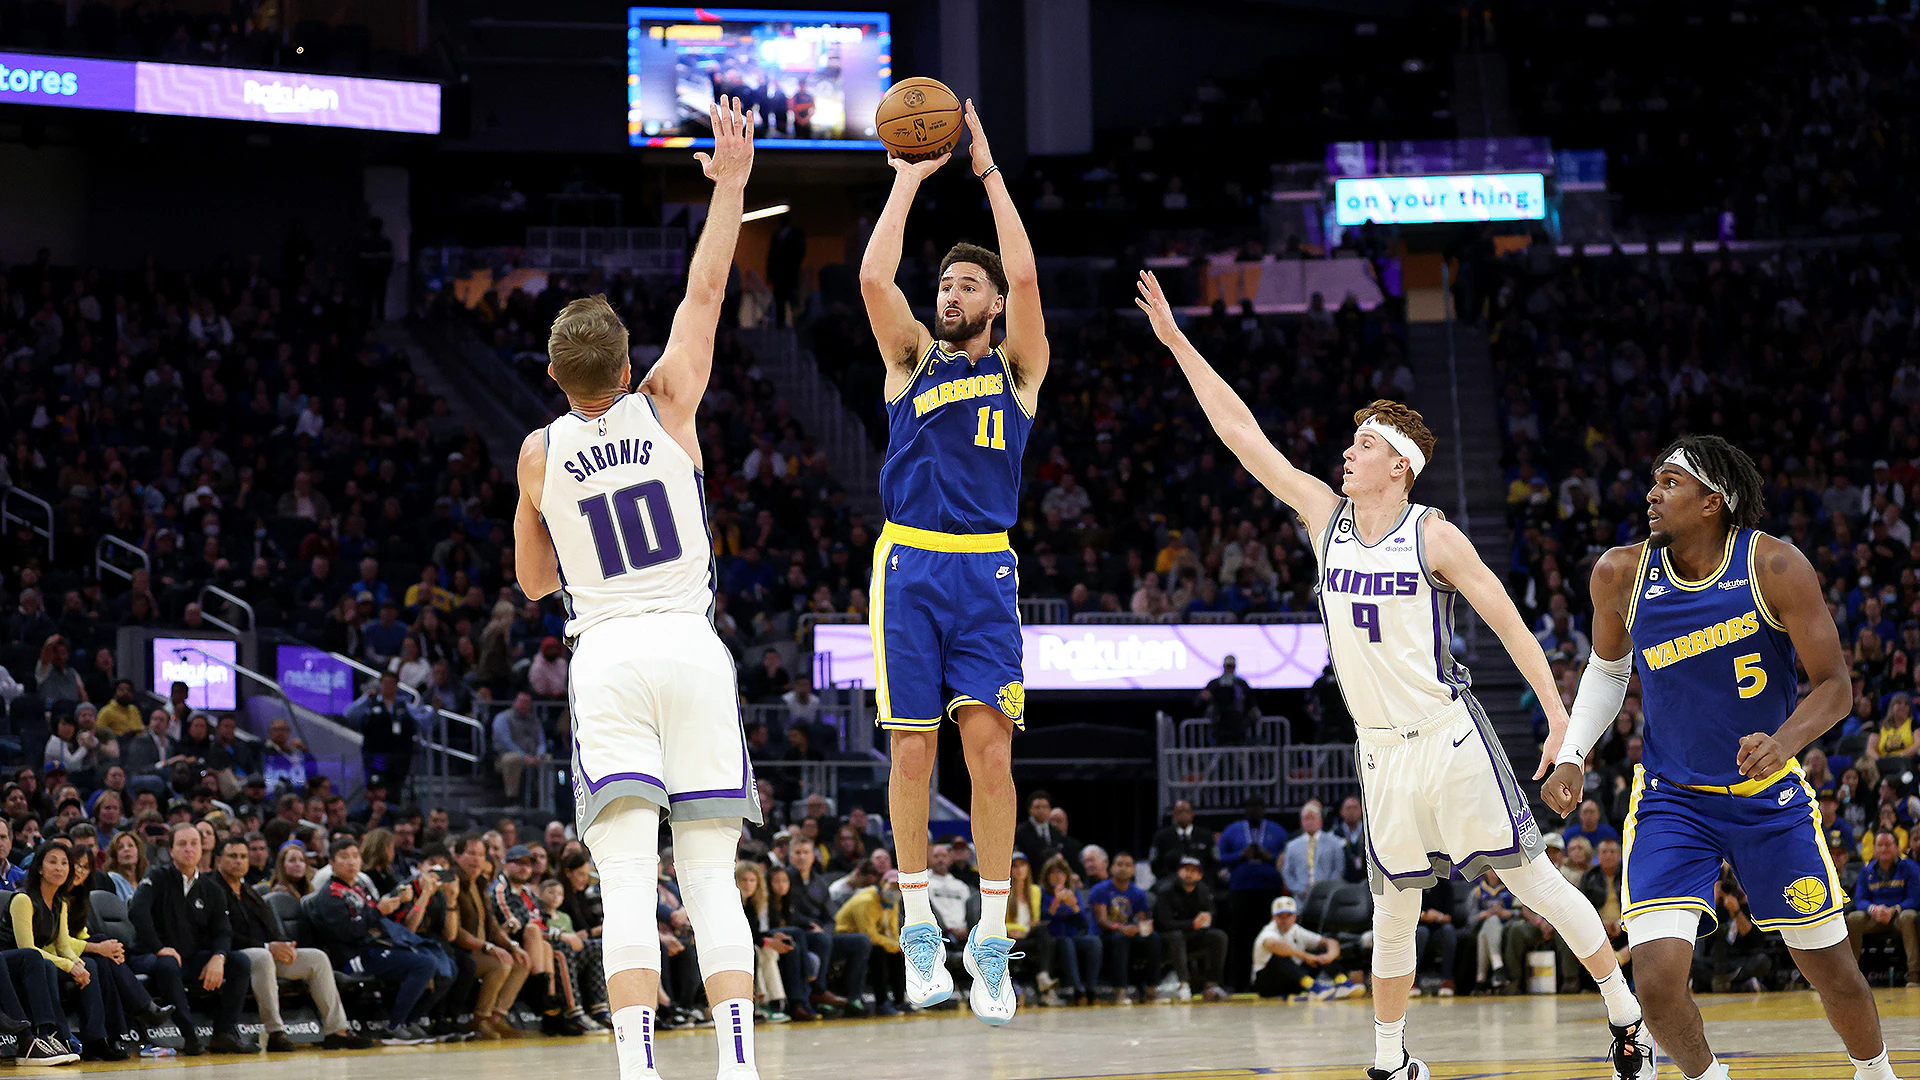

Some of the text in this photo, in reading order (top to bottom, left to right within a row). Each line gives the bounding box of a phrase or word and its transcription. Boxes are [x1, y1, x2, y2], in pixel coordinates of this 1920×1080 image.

[244, 80, 338, 111] Rakuten
[1347, 186, 1539, 213] on your thing.
[912, 373, 1004, 419] WARRIORS
[974, 405, 1006, 451] 11
[564, 438, 653, 483] SABONIS
[577, 478, 683, 581] 10
[1340, 520, 1352, 532] 6
[1326, 567, 1419, 596] KINGS
[1649, 567, 1660, 581] 6
[1718, 579, 1749, 590] Rakuten
[1351, 601, 1382, 643] 9
[1642, 610, 1760, 671] WARRIORS
[1039, 632, 1187, 672] Rakuten
[1733, 652, 1768, 699] 5
[147, 1026, 177, 1039] CHASE
